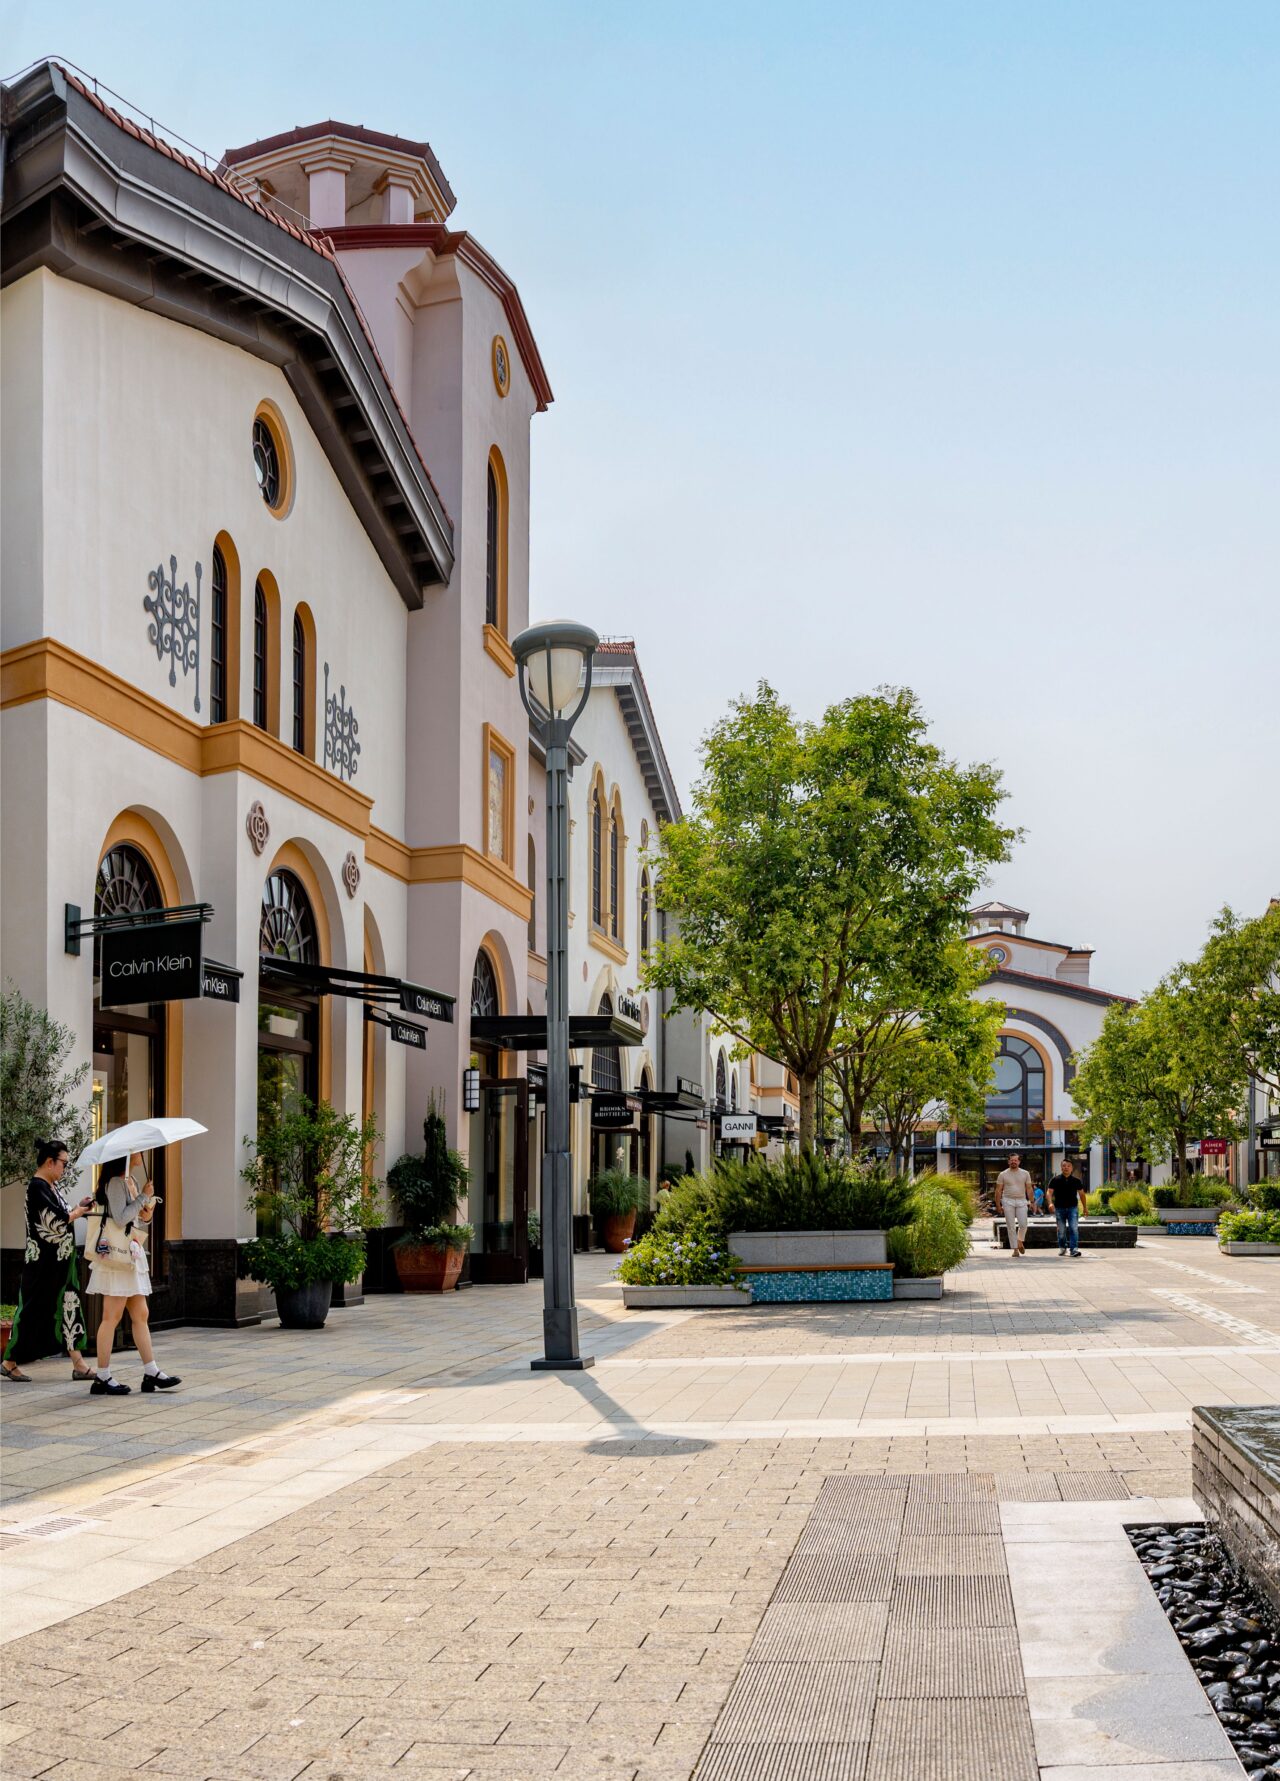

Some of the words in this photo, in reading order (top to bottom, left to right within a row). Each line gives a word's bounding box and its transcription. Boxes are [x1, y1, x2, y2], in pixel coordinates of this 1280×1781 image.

[109, 958, 154, 977] Calvin
[157, 955, 192, 972] Klein
[212, 977, 228, 995] Klein
[724, 1122, 754, 1131] GANNI
[988, 1138, 1021, 1147] TOD'S
